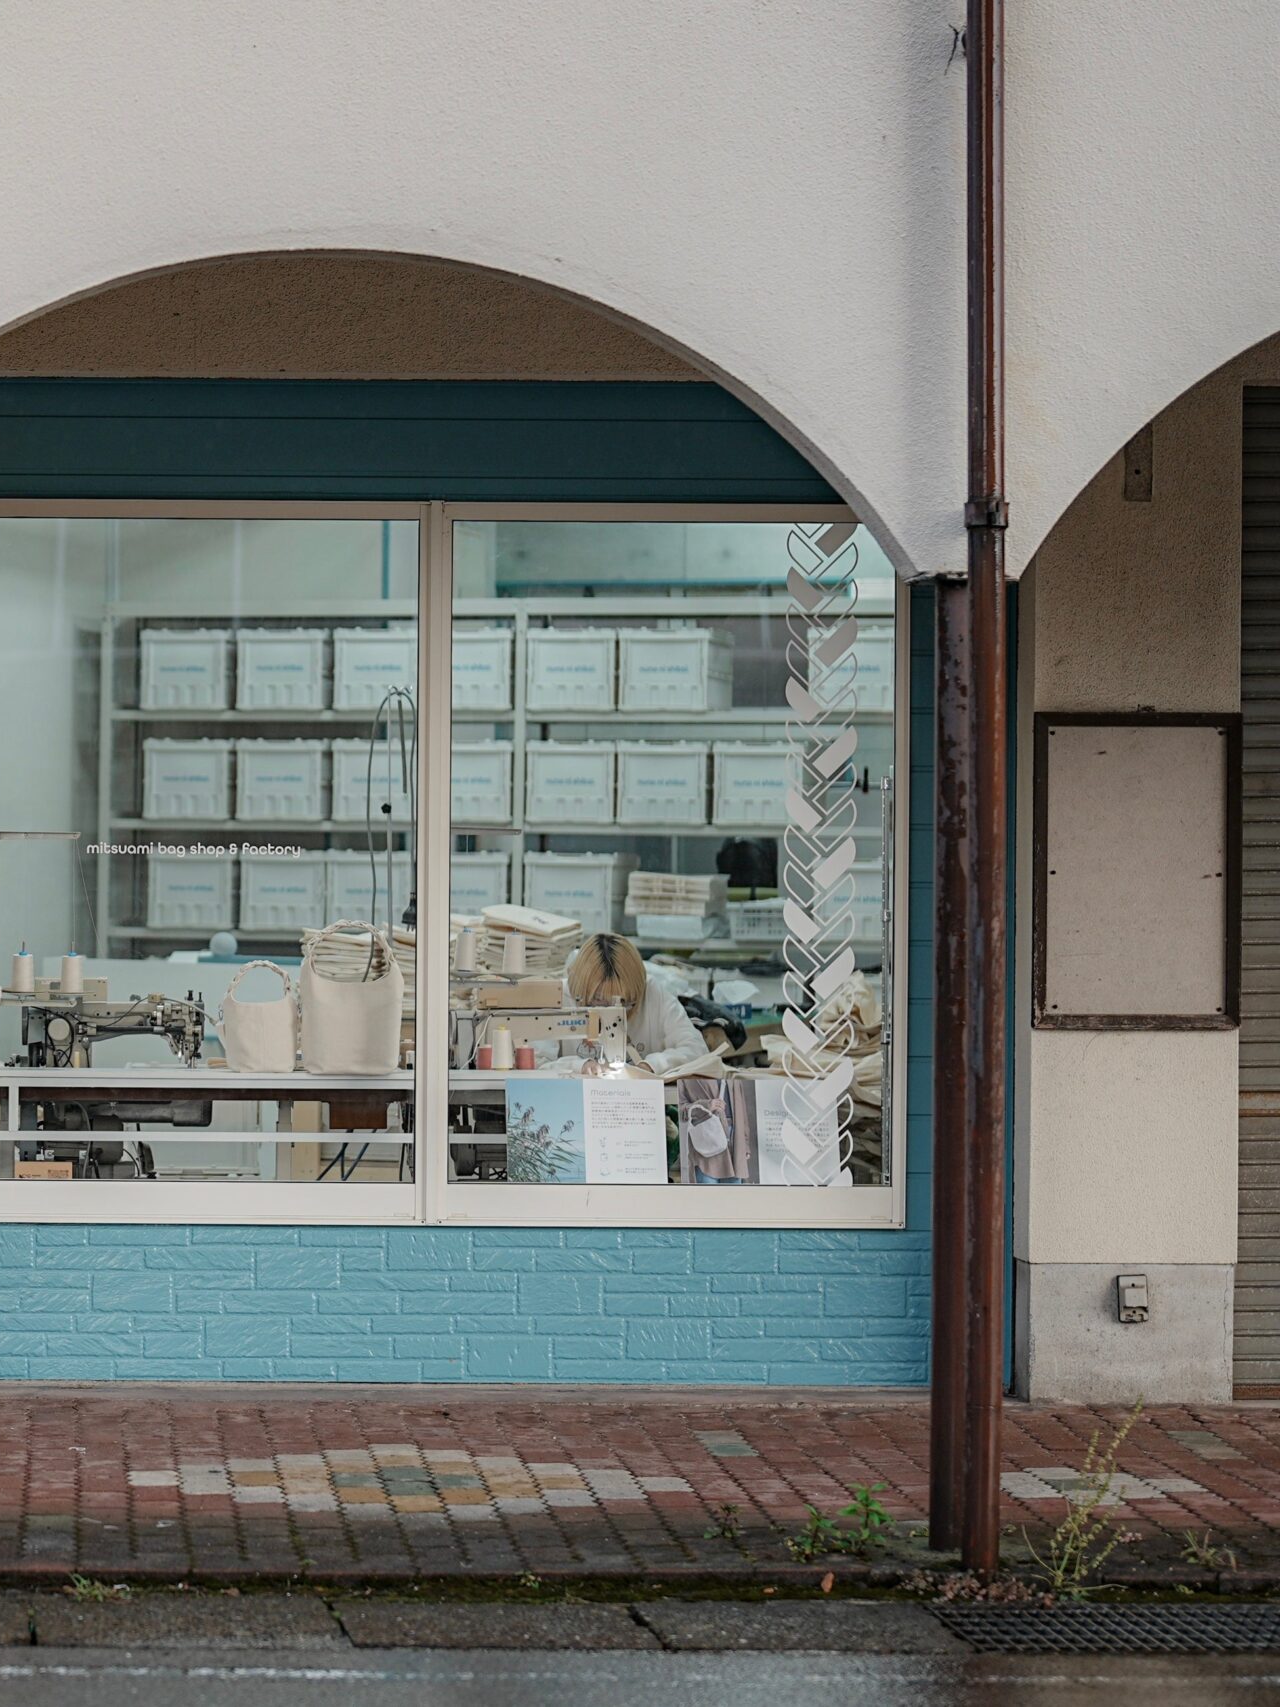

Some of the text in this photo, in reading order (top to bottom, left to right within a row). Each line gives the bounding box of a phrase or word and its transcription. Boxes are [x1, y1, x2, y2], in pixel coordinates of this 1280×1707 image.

[86, 841, 302, 858] mitsuami bag shop & factory
[559, 1019, 587, 1027] JUKI
